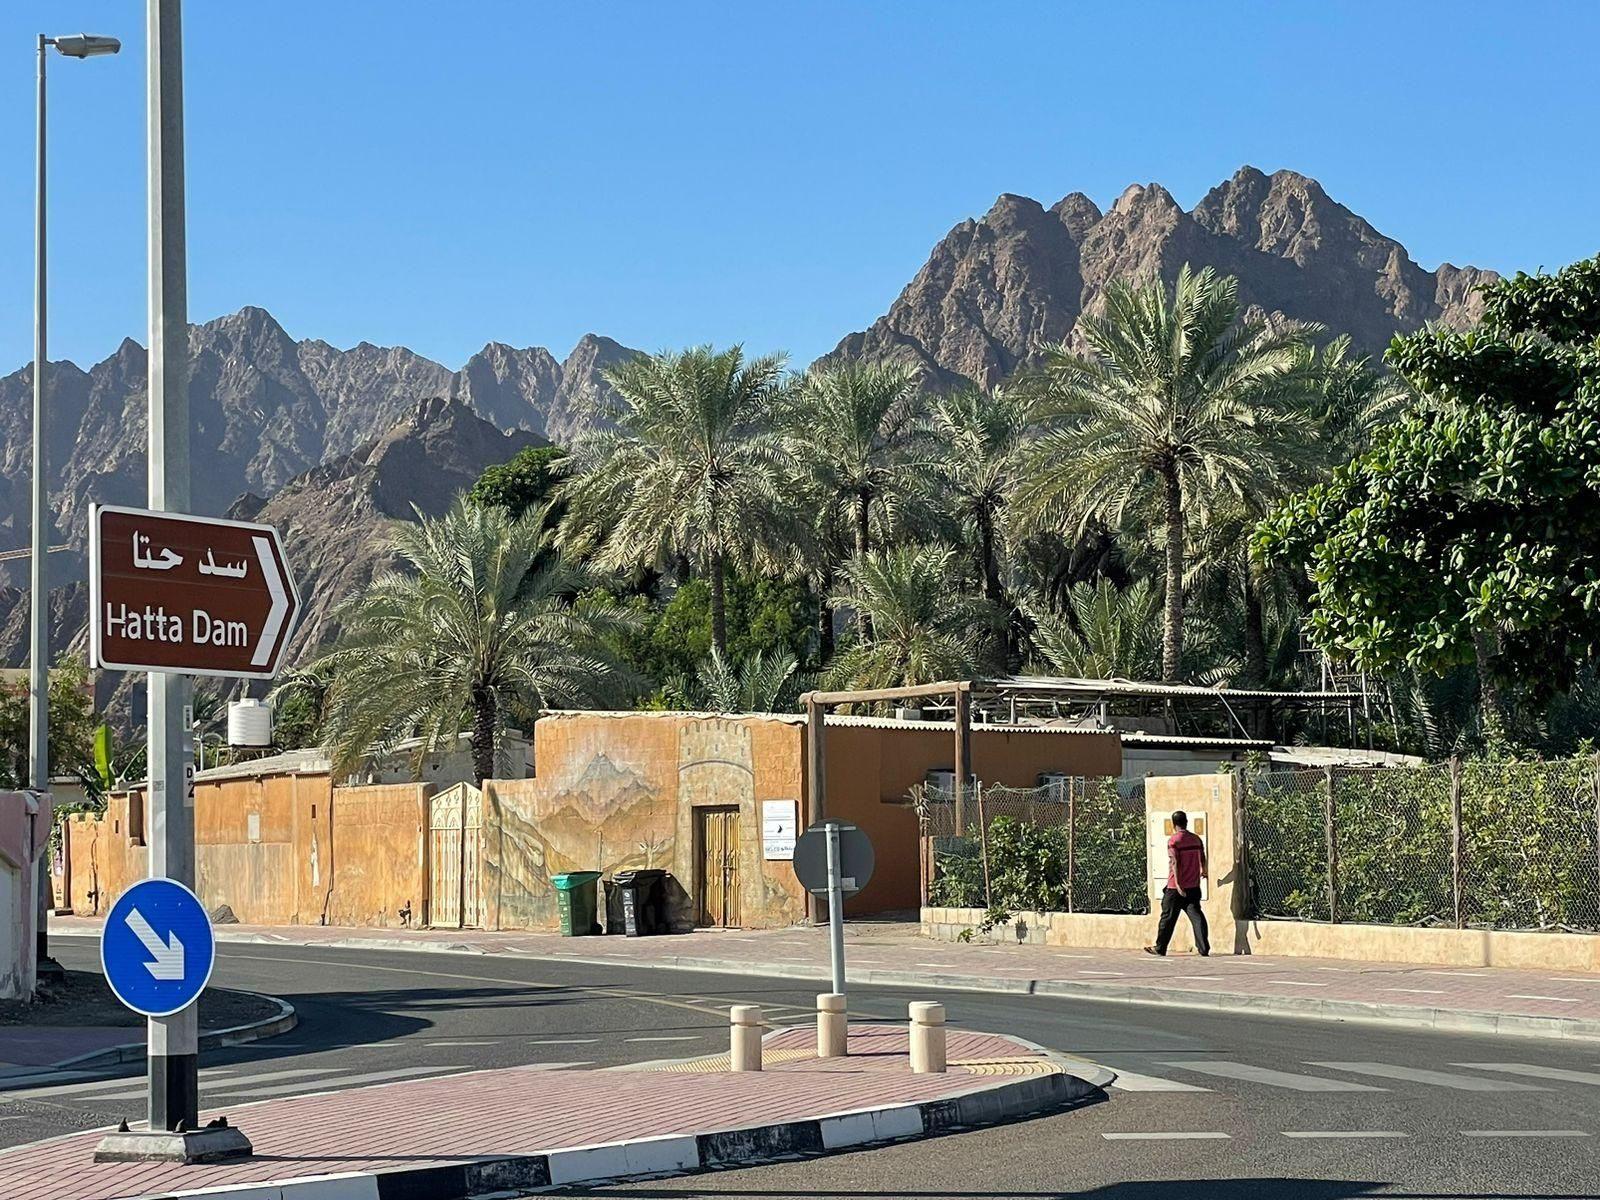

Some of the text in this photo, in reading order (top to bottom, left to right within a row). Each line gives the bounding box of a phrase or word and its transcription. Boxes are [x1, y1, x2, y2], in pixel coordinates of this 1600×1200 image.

[132, 530, 248, 578] سد حتا
[106, 602, 248, 647] Hatta Dam
